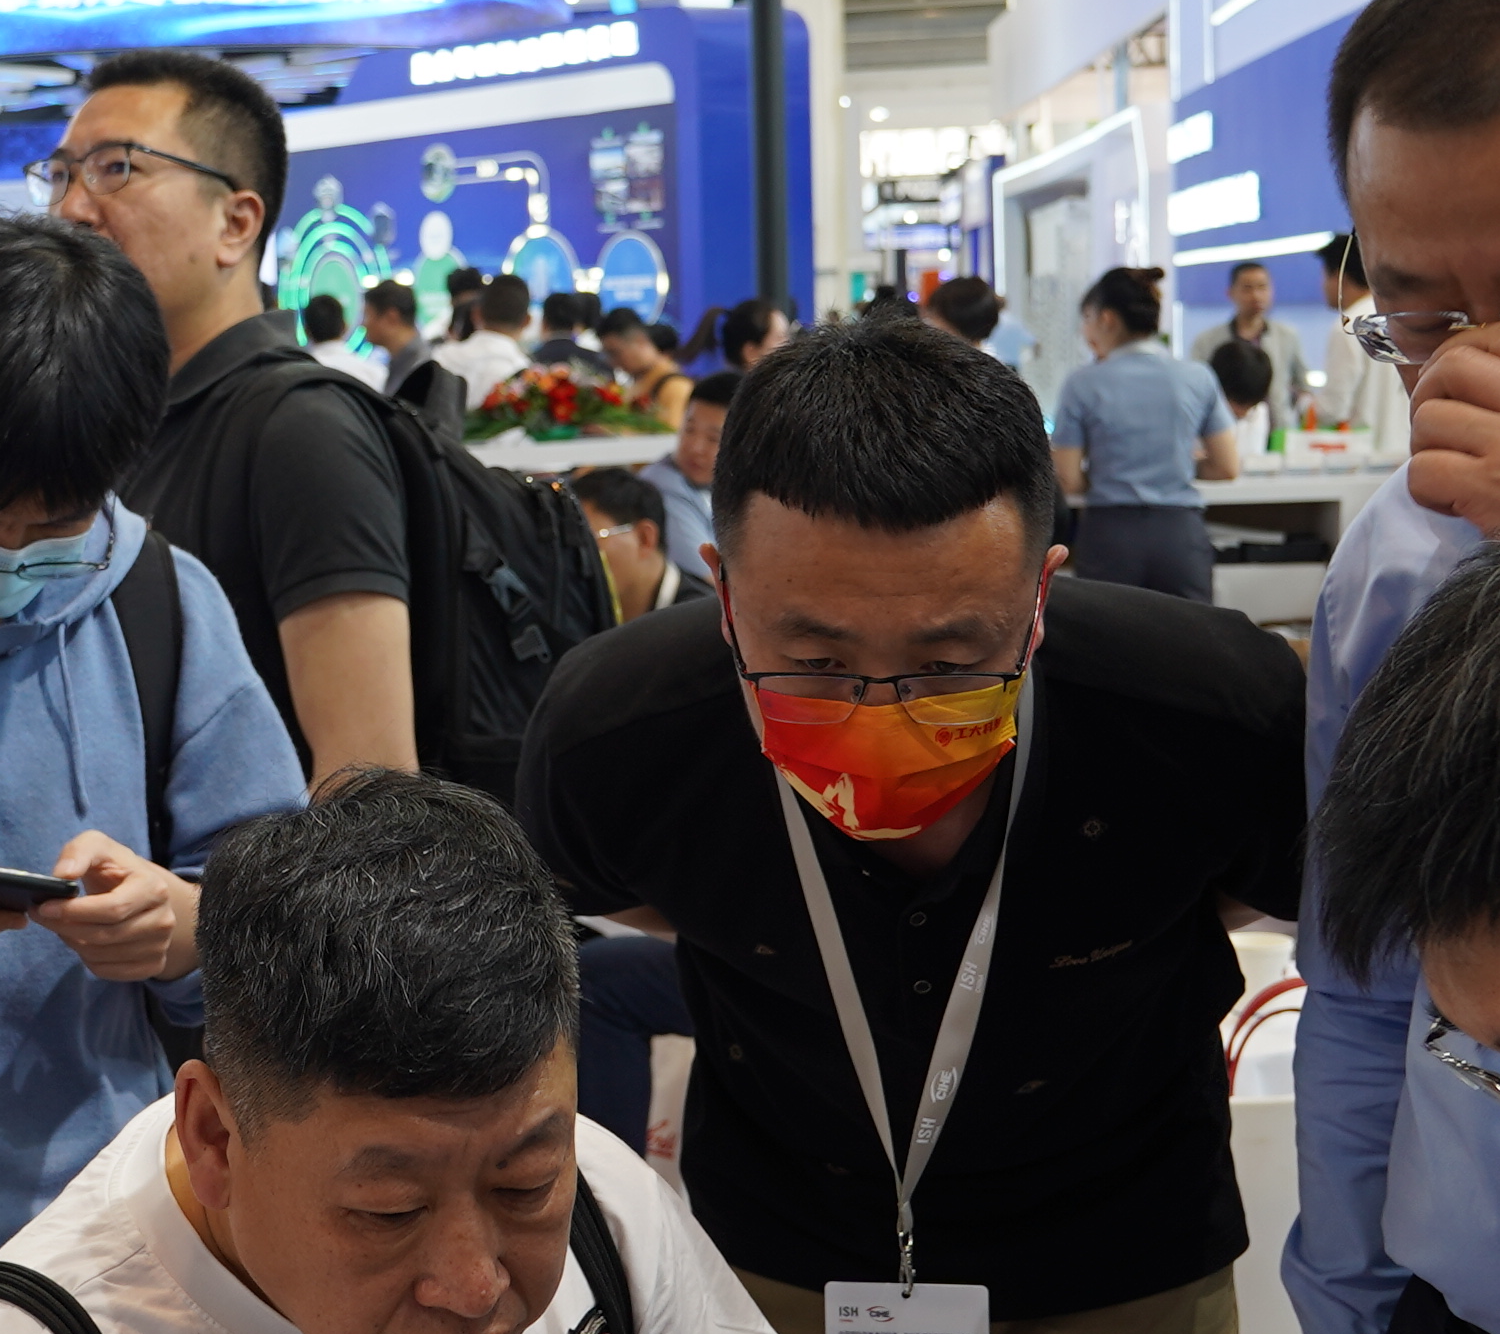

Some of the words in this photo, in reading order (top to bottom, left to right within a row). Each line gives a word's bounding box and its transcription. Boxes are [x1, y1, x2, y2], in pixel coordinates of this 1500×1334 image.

[959, 961, 978, 993] ISH
[935, 1069, 954, 1102] CIHE
[915, 1116, 937, 1145] ISH
[838, 1306, 859, 1317] ISH
